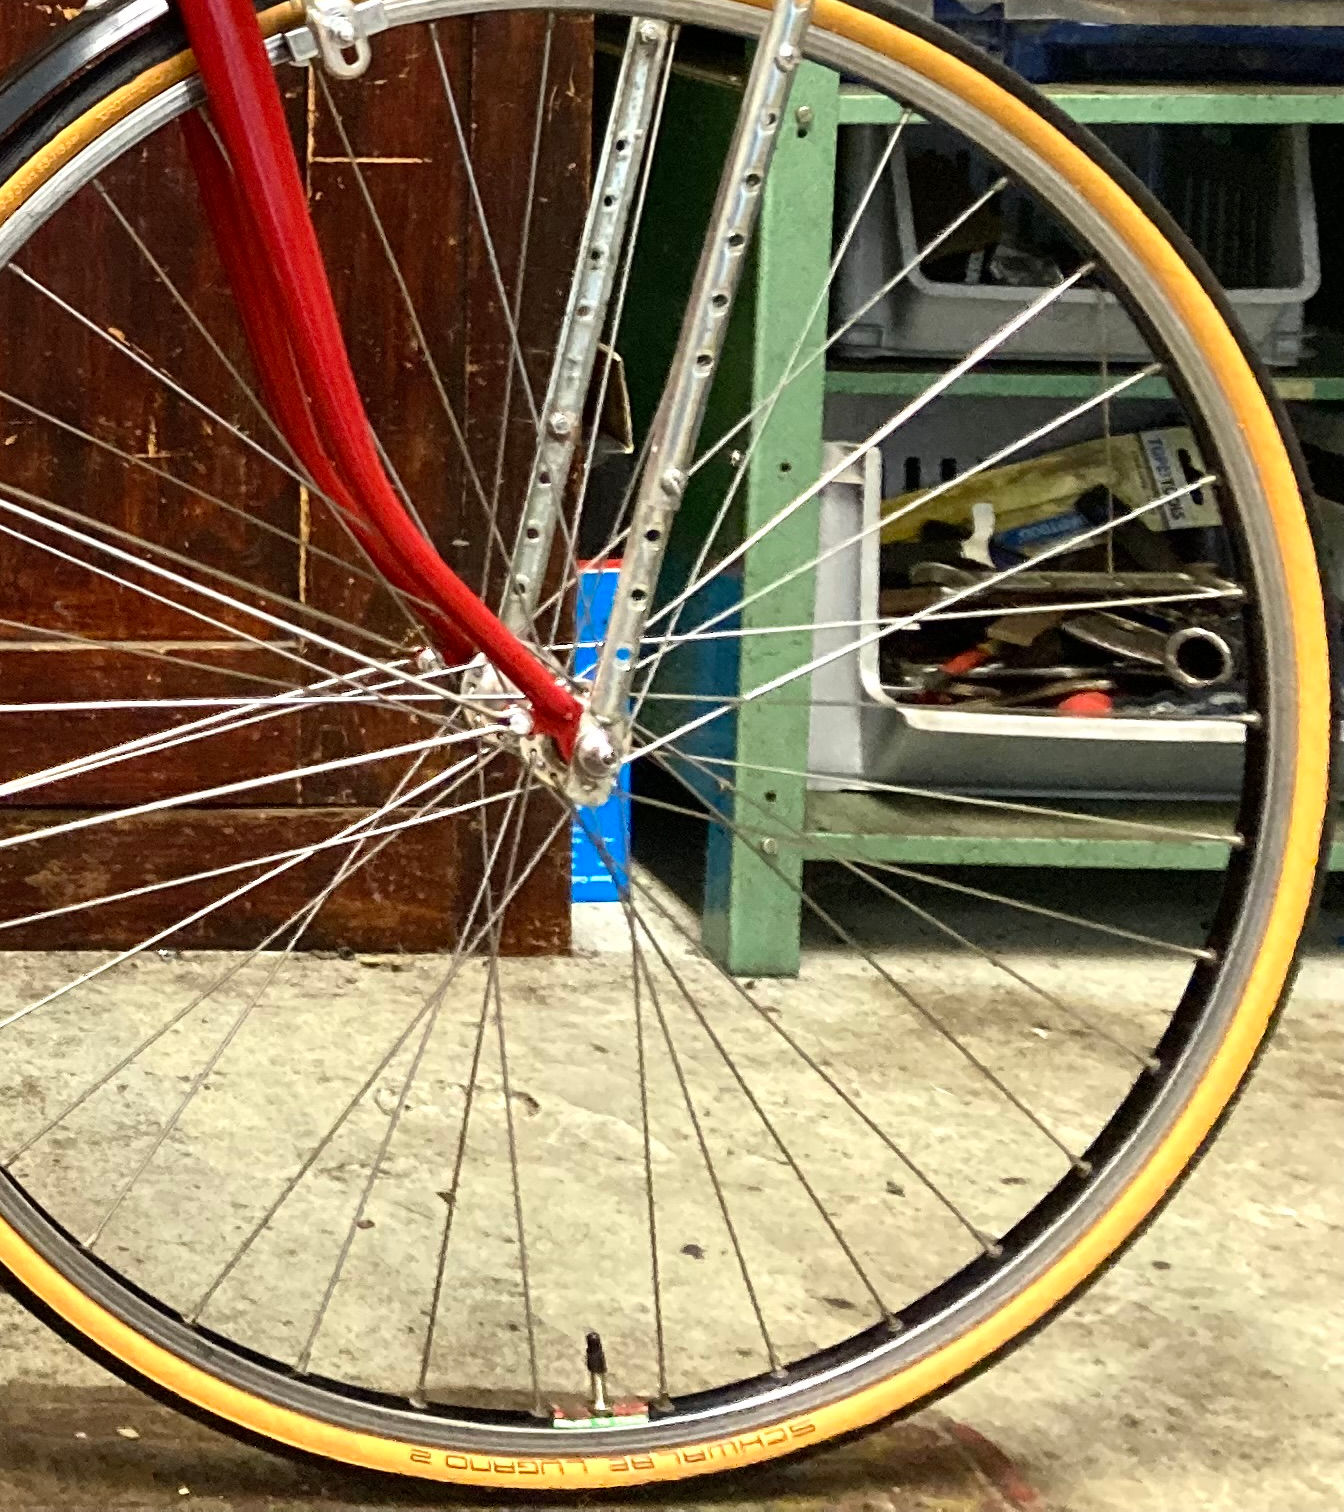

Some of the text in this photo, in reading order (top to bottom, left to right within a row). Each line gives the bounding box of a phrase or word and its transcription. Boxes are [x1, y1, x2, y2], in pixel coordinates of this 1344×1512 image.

[409, 1423, 816, 1476] SCHWALBE LUGANO 2
